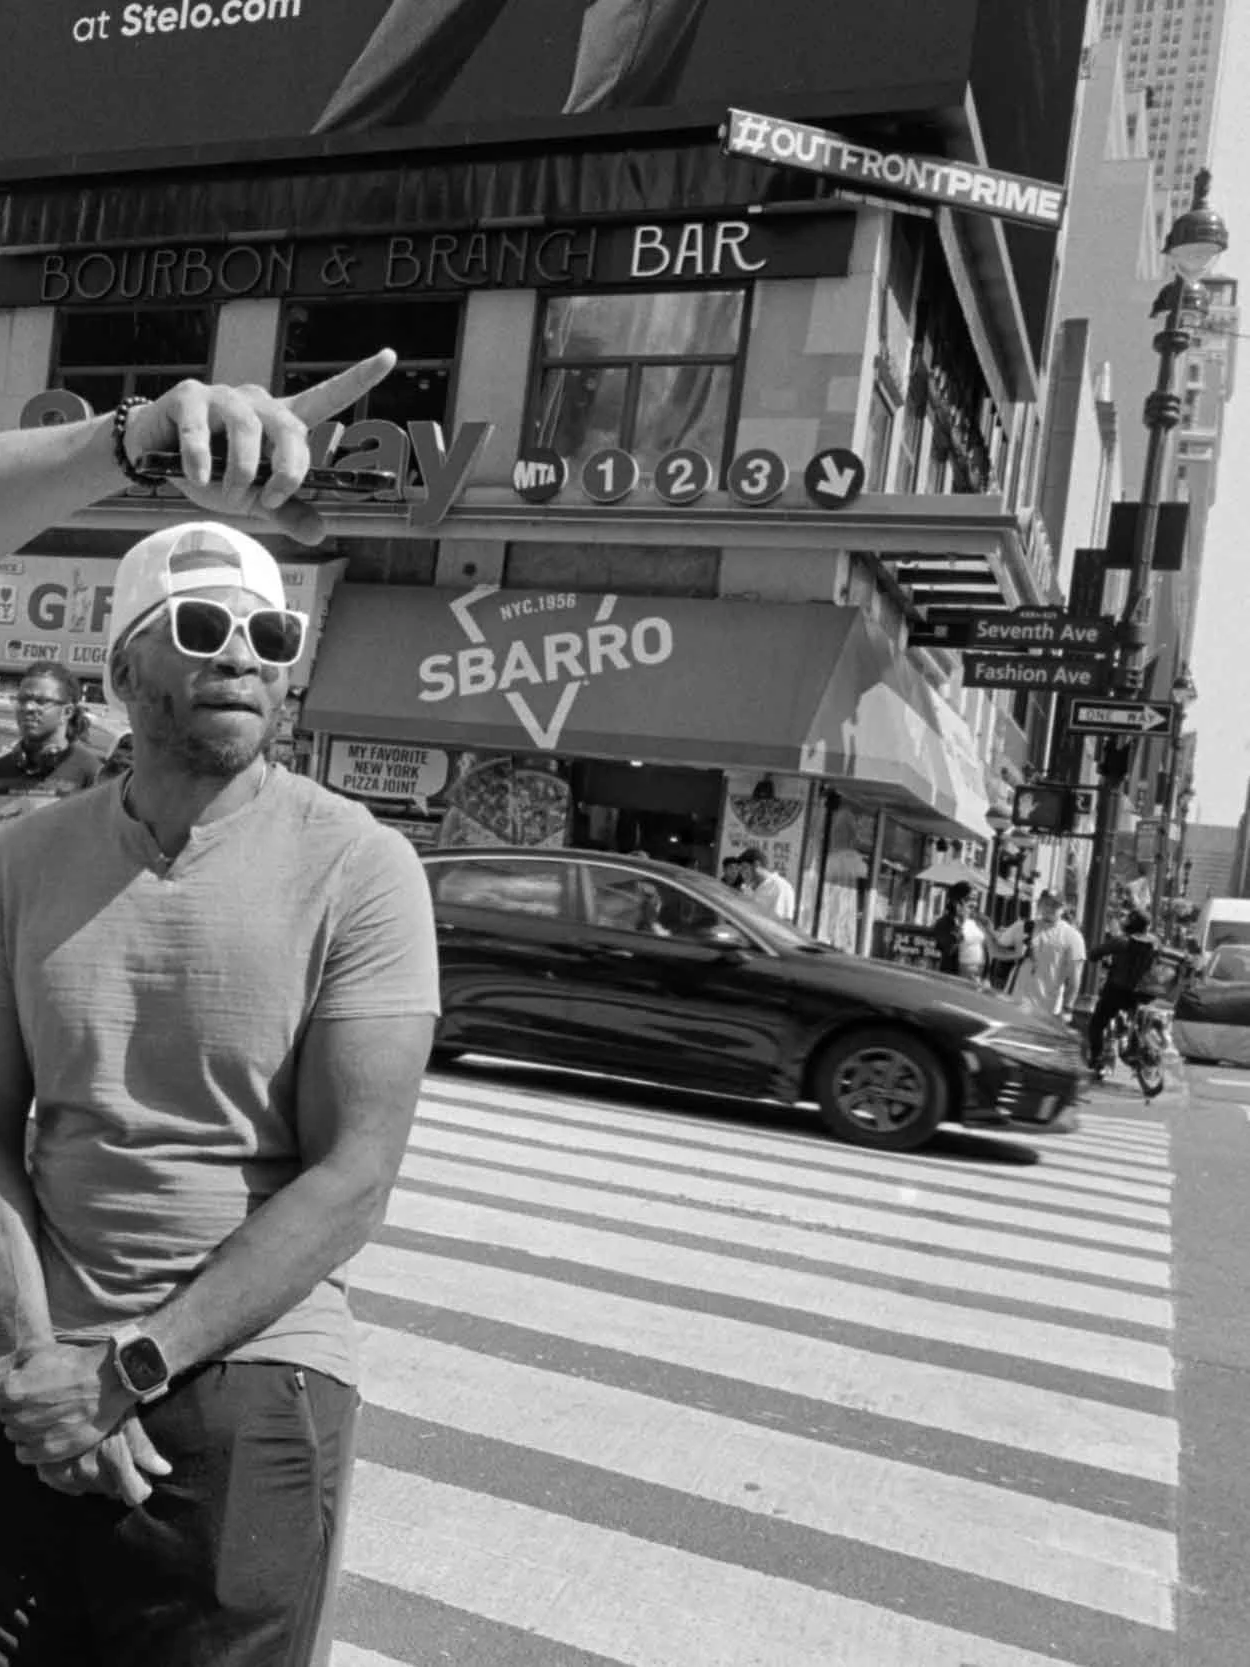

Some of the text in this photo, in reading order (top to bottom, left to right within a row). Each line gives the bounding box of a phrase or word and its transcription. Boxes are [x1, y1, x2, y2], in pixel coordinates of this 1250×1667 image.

[72, 0, 301, 42] at Stelo.com
[729, 116, 1063, 220] #OUTFRONTPRIME
[39, 220, 768, 302] BOURBON & BRANCH BAR
[513, 460, 558, 489] MTA
[597, 457, 772, 494] 1 2 3
[498, 591, 577, 622] NYC.1956
[976, 619, 1099, 643] Seventh Ave
[418, 616, 674, 702] SBARRO
[974, 662, 1092, 686] Fashion Ave
[1083, 707, 1113, 722] ONE
[348, 744, 430, 765] MY FAVORITE
[342, 774, 380, 791] PIZZA
[353, 759, 421, 780] NEW YORK
